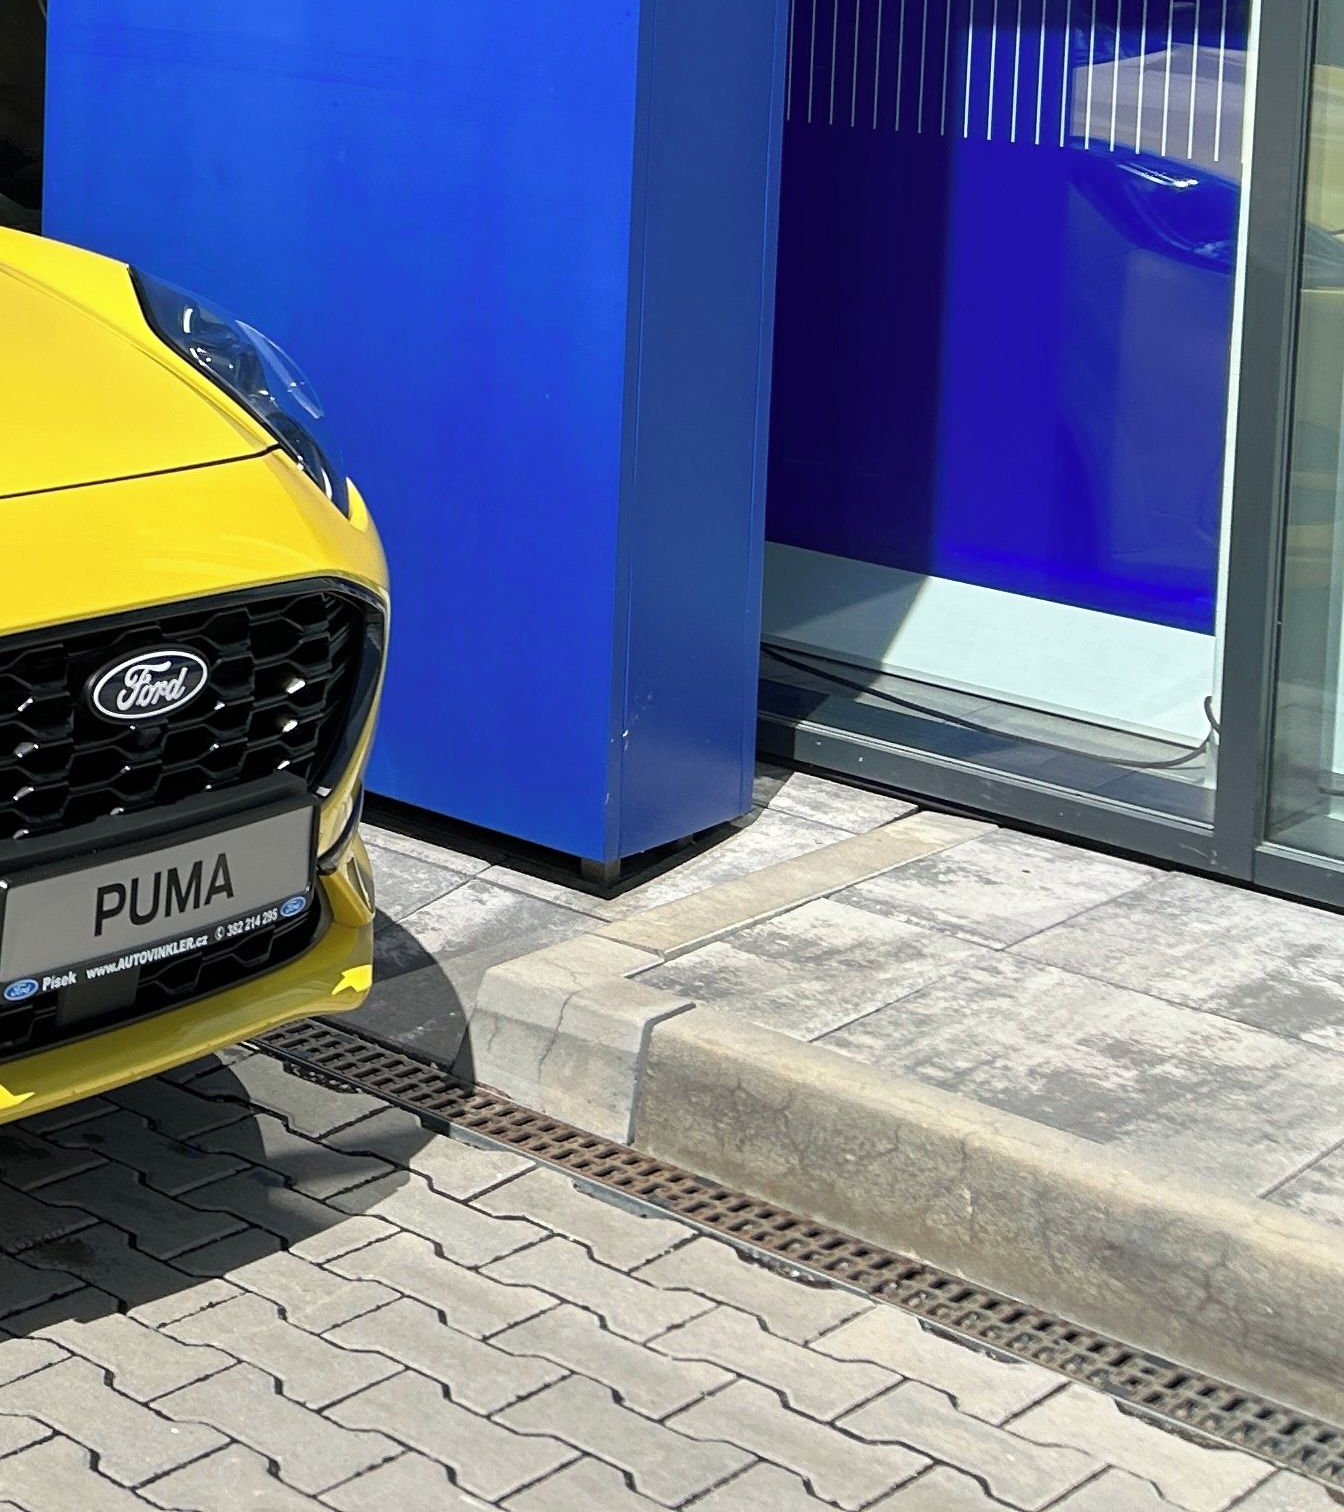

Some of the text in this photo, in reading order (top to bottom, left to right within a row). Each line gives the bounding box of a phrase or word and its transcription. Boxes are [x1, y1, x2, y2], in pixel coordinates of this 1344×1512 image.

[116, 661, 188, 711] Ford
[94, 852, 235, 938] PUMA
[85, 935, 209, 980] www.AUTOVINKLER.cz
